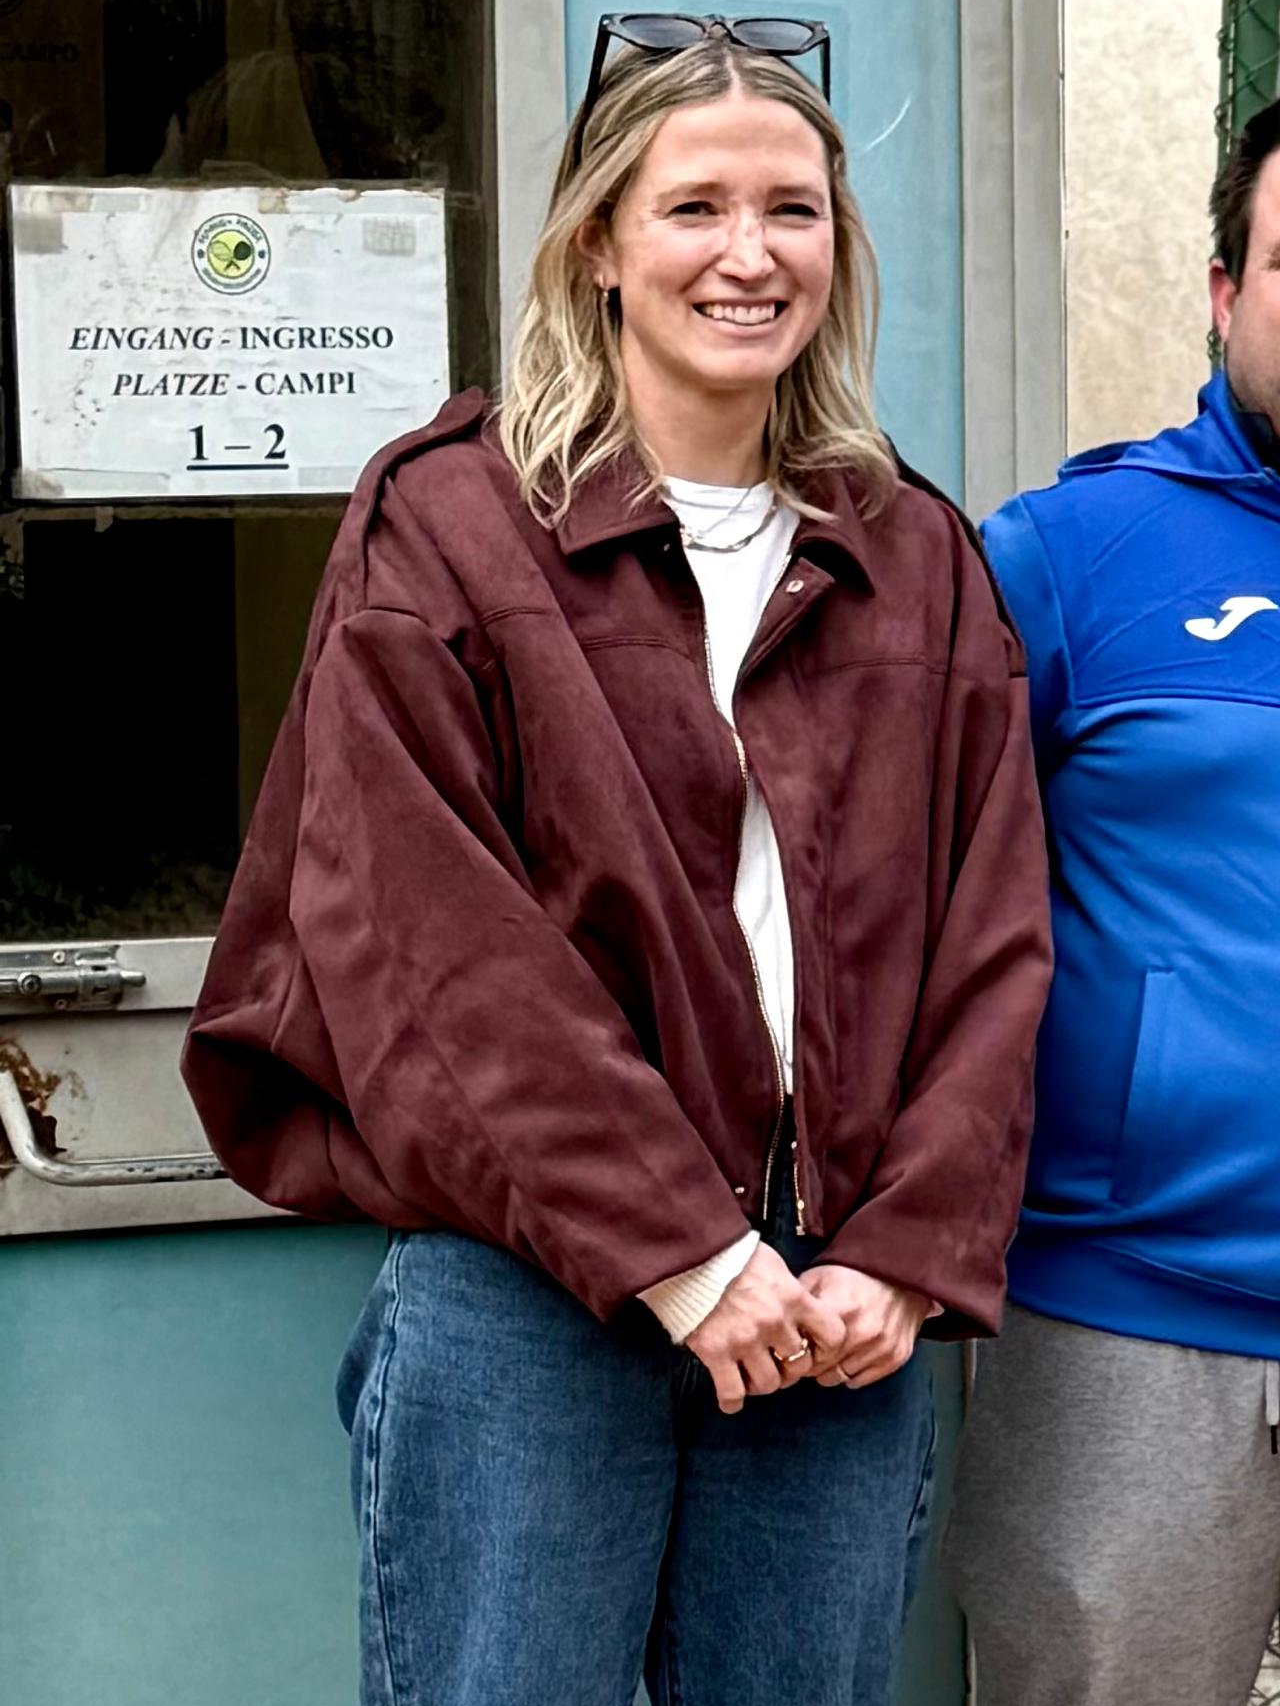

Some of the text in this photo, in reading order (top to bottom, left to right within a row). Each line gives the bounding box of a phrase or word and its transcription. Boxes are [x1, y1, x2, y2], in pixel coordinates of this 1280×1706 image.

[68, 326, 215, 351] EINGANG
[240, 325, 394, 350] INGRESSO
[111, 372, 231, 397] PLATZE
[254, 370, 357, 396] CAMPI
[188, 424, 209, 462] 1
[264, 423, 287, 460] 2
